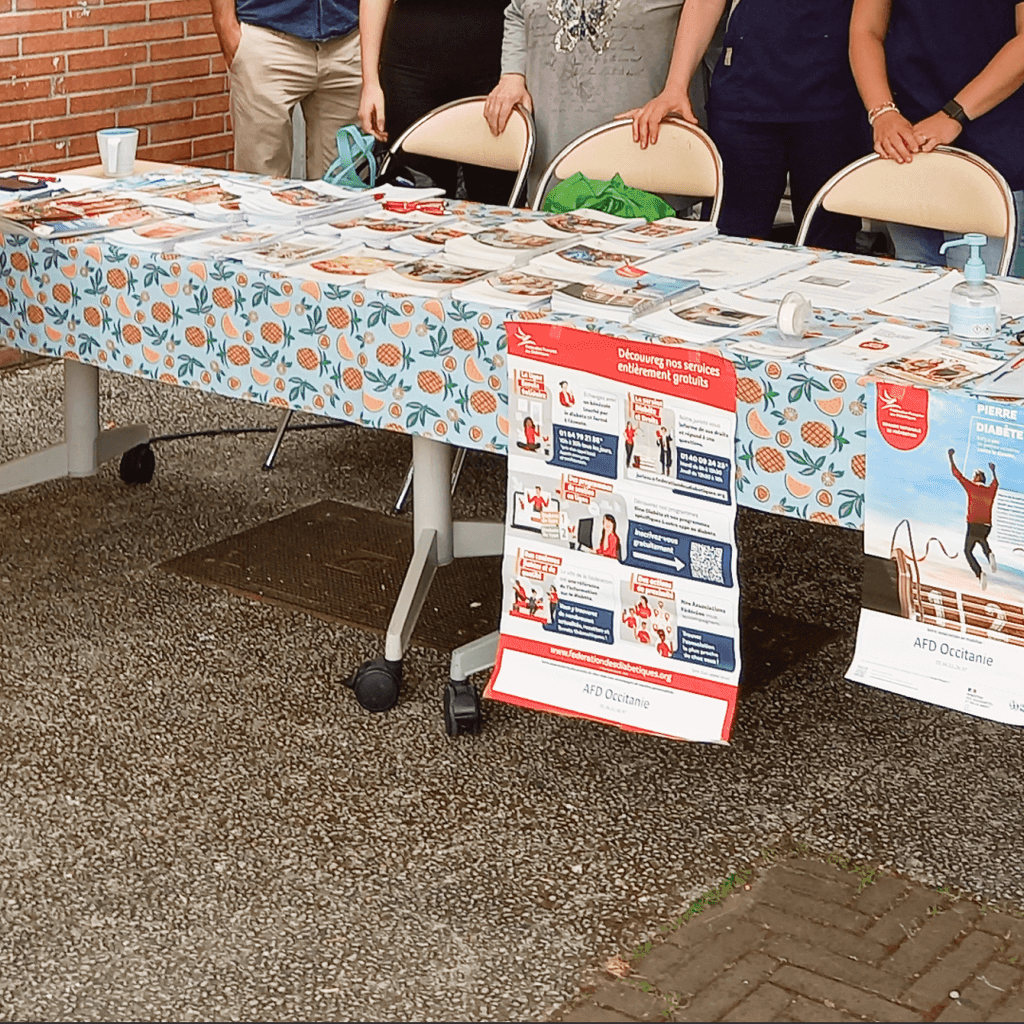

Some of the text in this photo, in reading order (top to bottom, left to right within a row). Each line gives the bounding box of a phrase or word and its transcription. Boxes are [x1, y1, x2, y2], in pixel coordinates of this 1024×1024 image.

[618, 348, 721, 377] Découvrez nos services
[618, 362, 709, 388] entièrement gratuits
[977, 404, 1017, 420] PIERRE
[976, 422, 1024, 440] DIABÈTE
[913, 637, 937, 652] AFD
[940, 643, 994, 666] Occitanie
[583, 683, 603, 697] AFD
[605, 688, 651, 709] Occitanie
